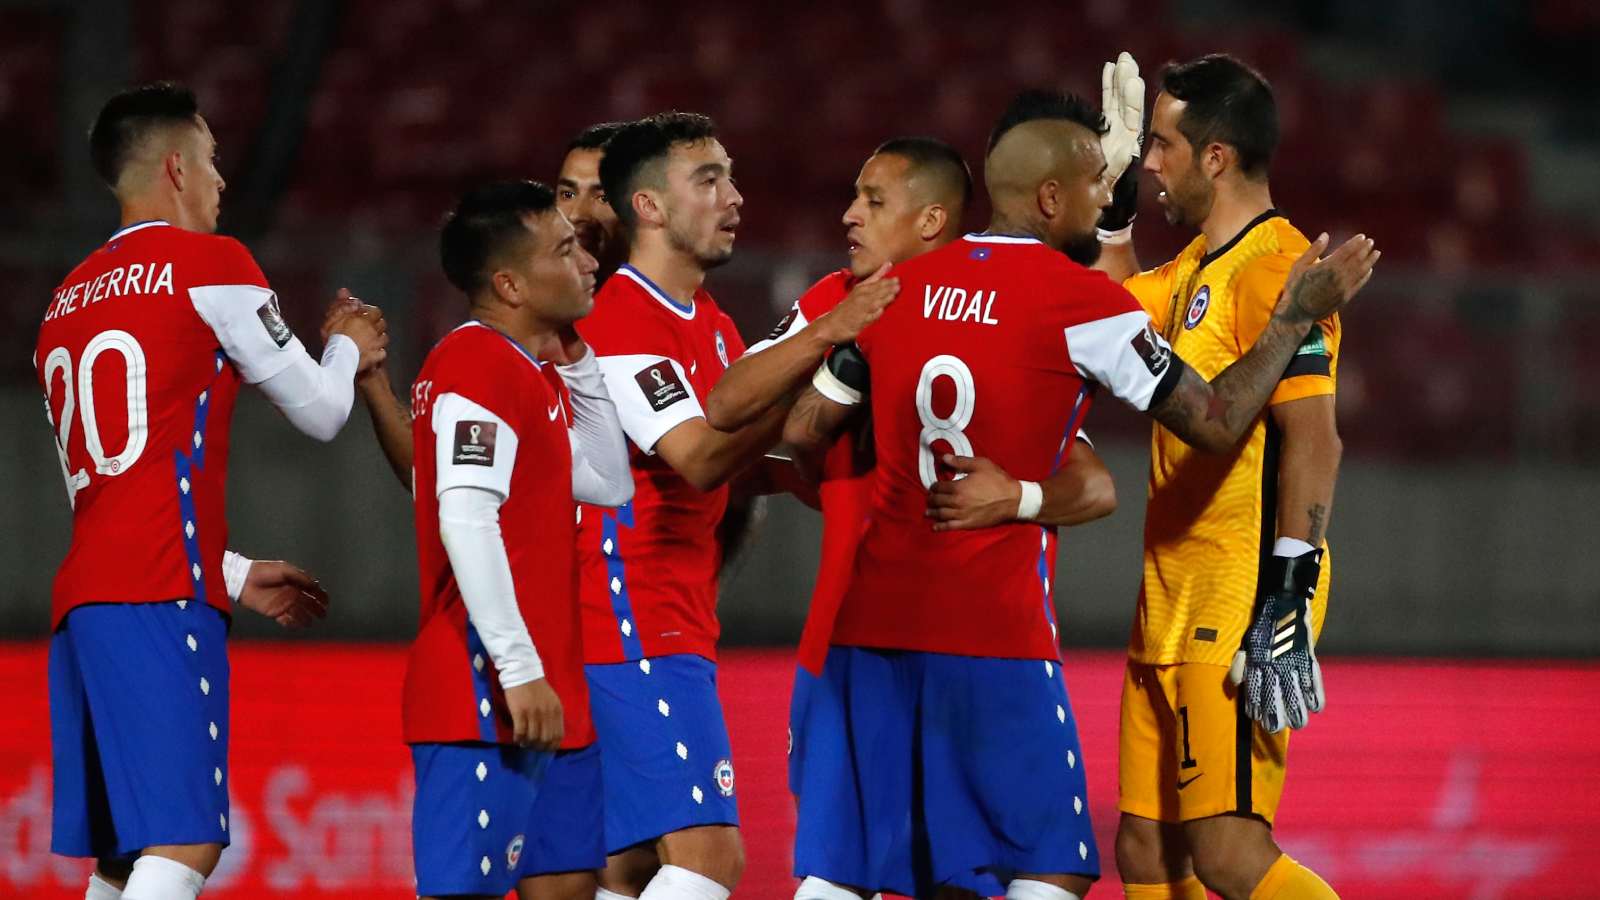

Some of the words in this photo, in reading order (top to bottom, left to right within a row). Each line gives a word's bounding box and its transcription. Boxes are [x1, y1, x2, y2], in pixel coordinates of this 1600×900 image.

[923, 284, 998, 325] VIDAL
[41, 329, 148, 511] 20
[916, 354, 976, 491] 8
[1179, 705, 1197, 769] 1
